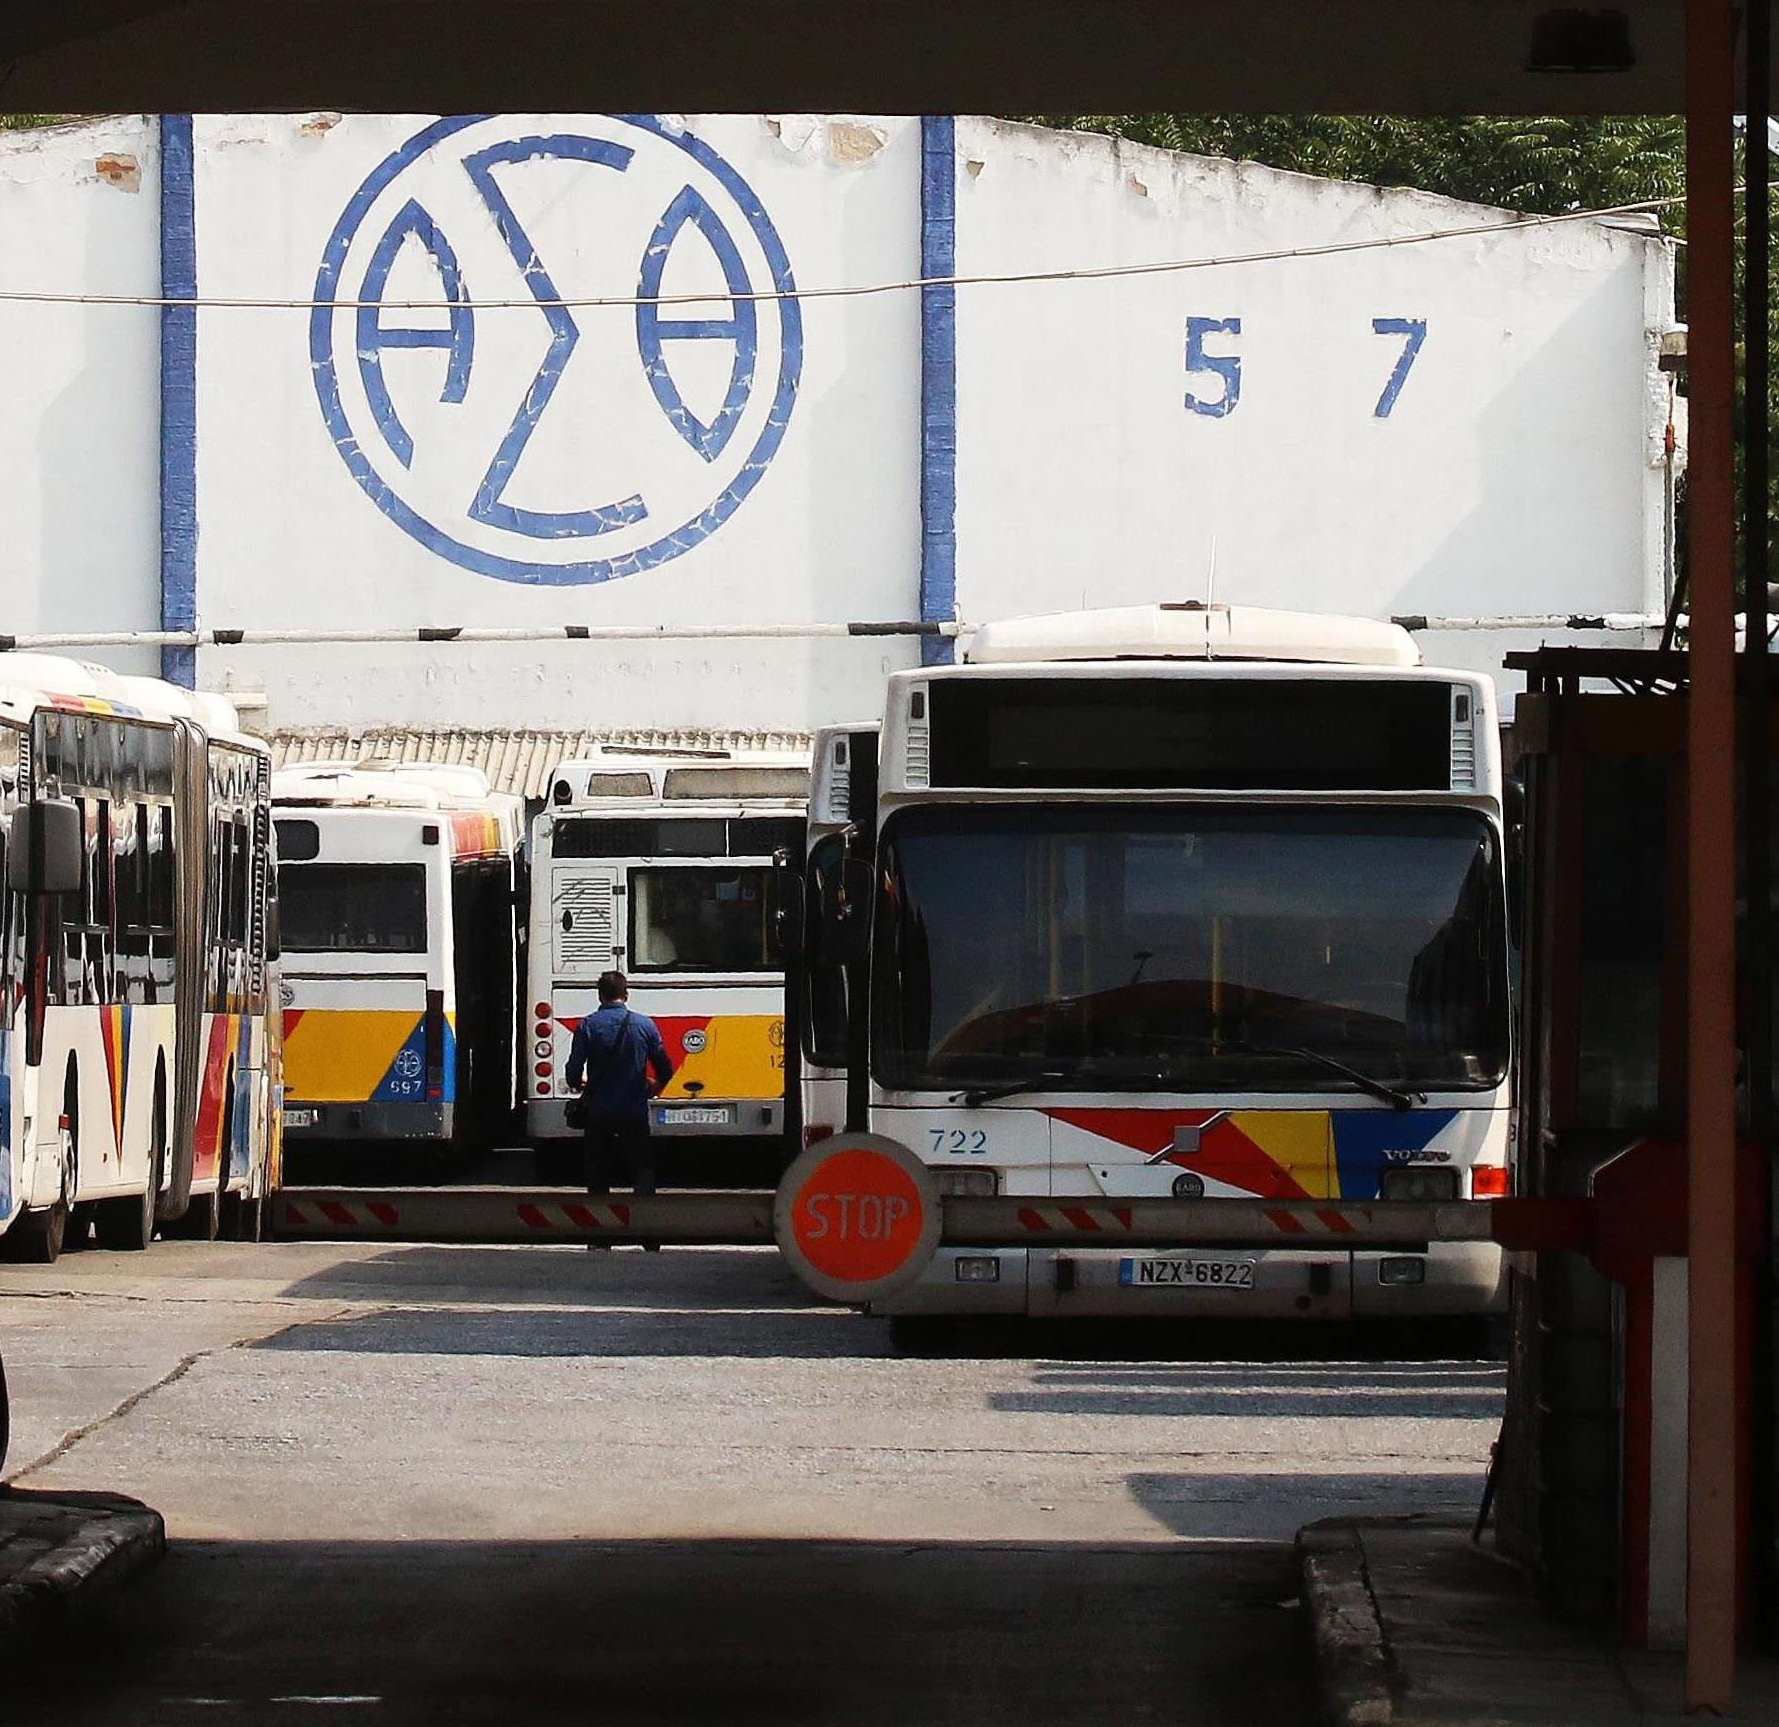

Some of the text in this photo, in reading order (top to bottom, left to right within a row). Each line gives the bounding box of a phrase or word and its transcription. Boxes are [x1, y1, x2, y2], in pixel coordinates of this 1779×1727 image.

[1184, 316, 1241, 419] 5
[1372, 318, 1427, 418] 7
[929, 1129, 987, 1154] 722
[805, 1192, 910, 1241] STOP
